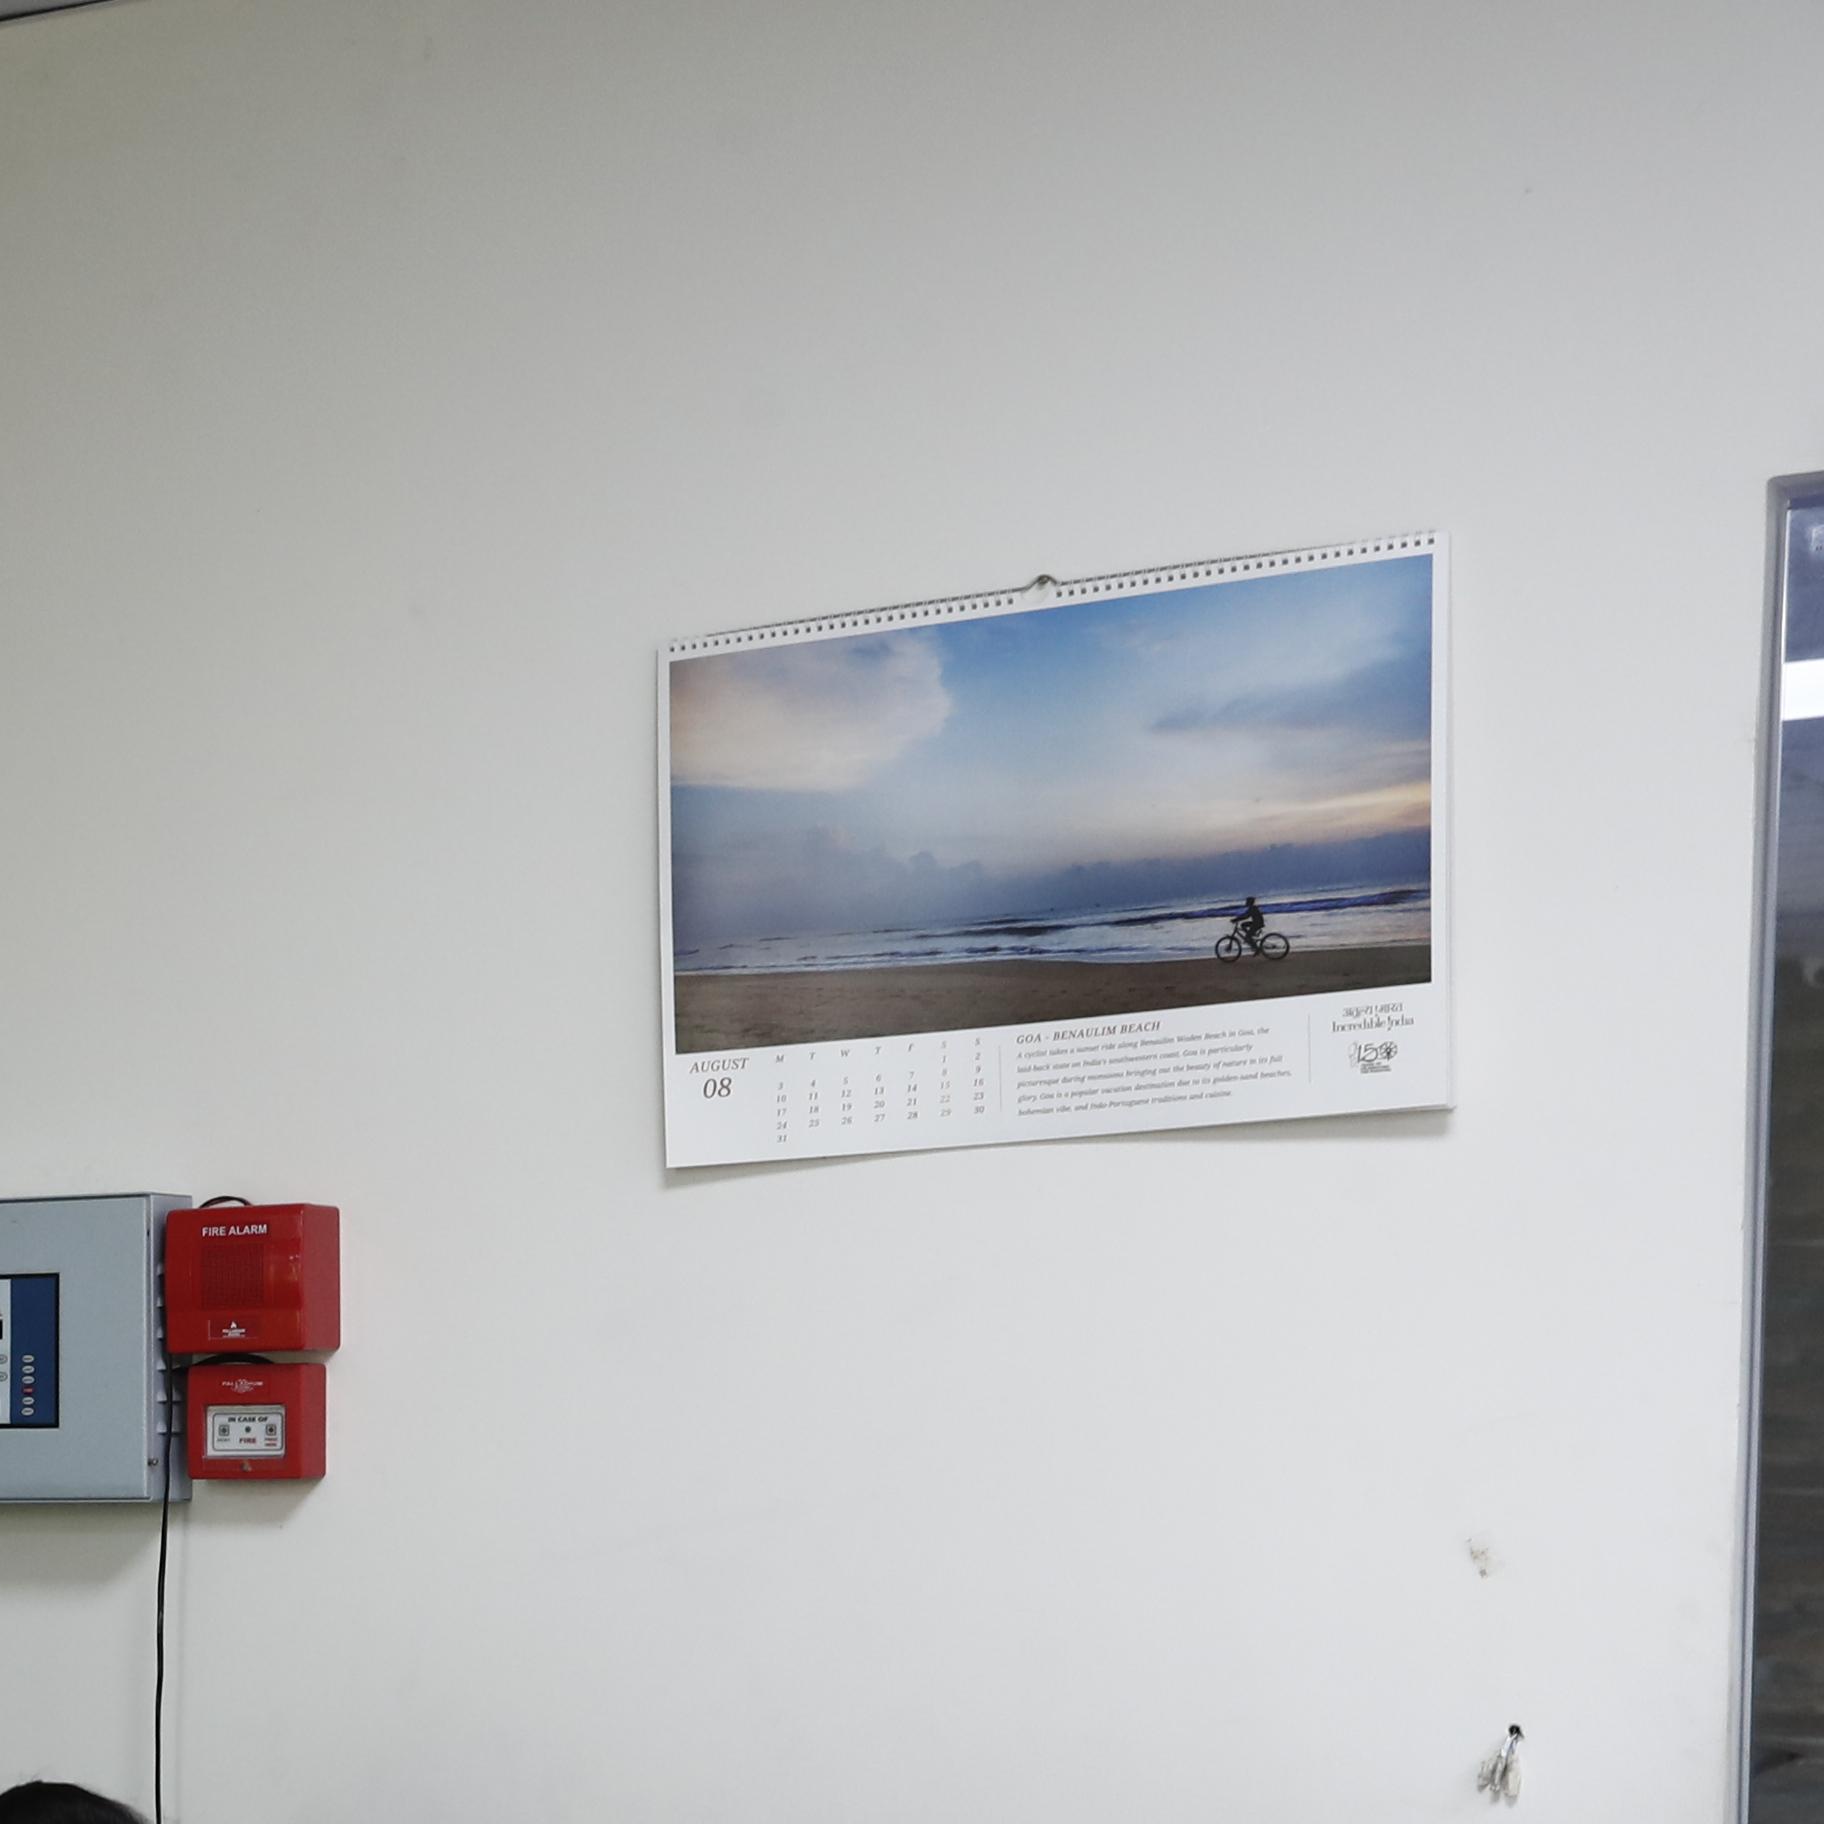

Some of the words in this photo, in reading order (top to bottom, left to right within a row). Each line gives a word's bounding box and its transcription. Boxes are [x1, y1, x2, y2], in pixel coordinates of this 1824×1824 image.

[1016, 1033, 1041, 1044] GOA
[1052, 1025, 1116, 1041] BENAULIM
[1120, 1020, 1160, 1034] BEACH
[775, 1055, 784, 1063] M
[809, 1052, 815, 1060] T
[840, 1049, 850, 1057] W
[875, 1047, 881, 1055] T
[908, 1044, 914, 1052] F
[941, 1041, 947, 1049] S
[975, 1038, 980, 1046] S
[690, 1058, 749, 1074] AUGUST
[704, 1078, 732, 1098] 08
[777, 1095, 786, 1103] 10
[809, 1092, 818, 1100] 11
[841, 1089, 851, 1098] 12
[874, 1087, 884, 1095] 13
[907, 1084, 917, 1093] 14
[940, 1081, 950, 1089] 15
[974, 1078, 984, 1087] 16
[777, 1108, 786, 1117] 17
[809, 1106, 819, 1114] 18
[842, 1103, 851, 1111] 19
[907, 1098, 917, 1106] 21
[940, 1095, 950, 1103] 22
[974, 1092, 984, 1100] 23
[777, 1122, 787, 1130] 24
[809, 1119, 819, 1128] 25
[841, 1117, 852, 1125] 26
[875, 1114, 885, 1123] 27
[908, 1111, 918, 1120] 28
[941, 1108, 951, 1117] 29
[974, 1106, 984, 1114] 30
[777, 1135, 787, 1143] 31
[202, 1226, 226, 1237] FIRE
[228, 1224, 268, 1236] ALARM
